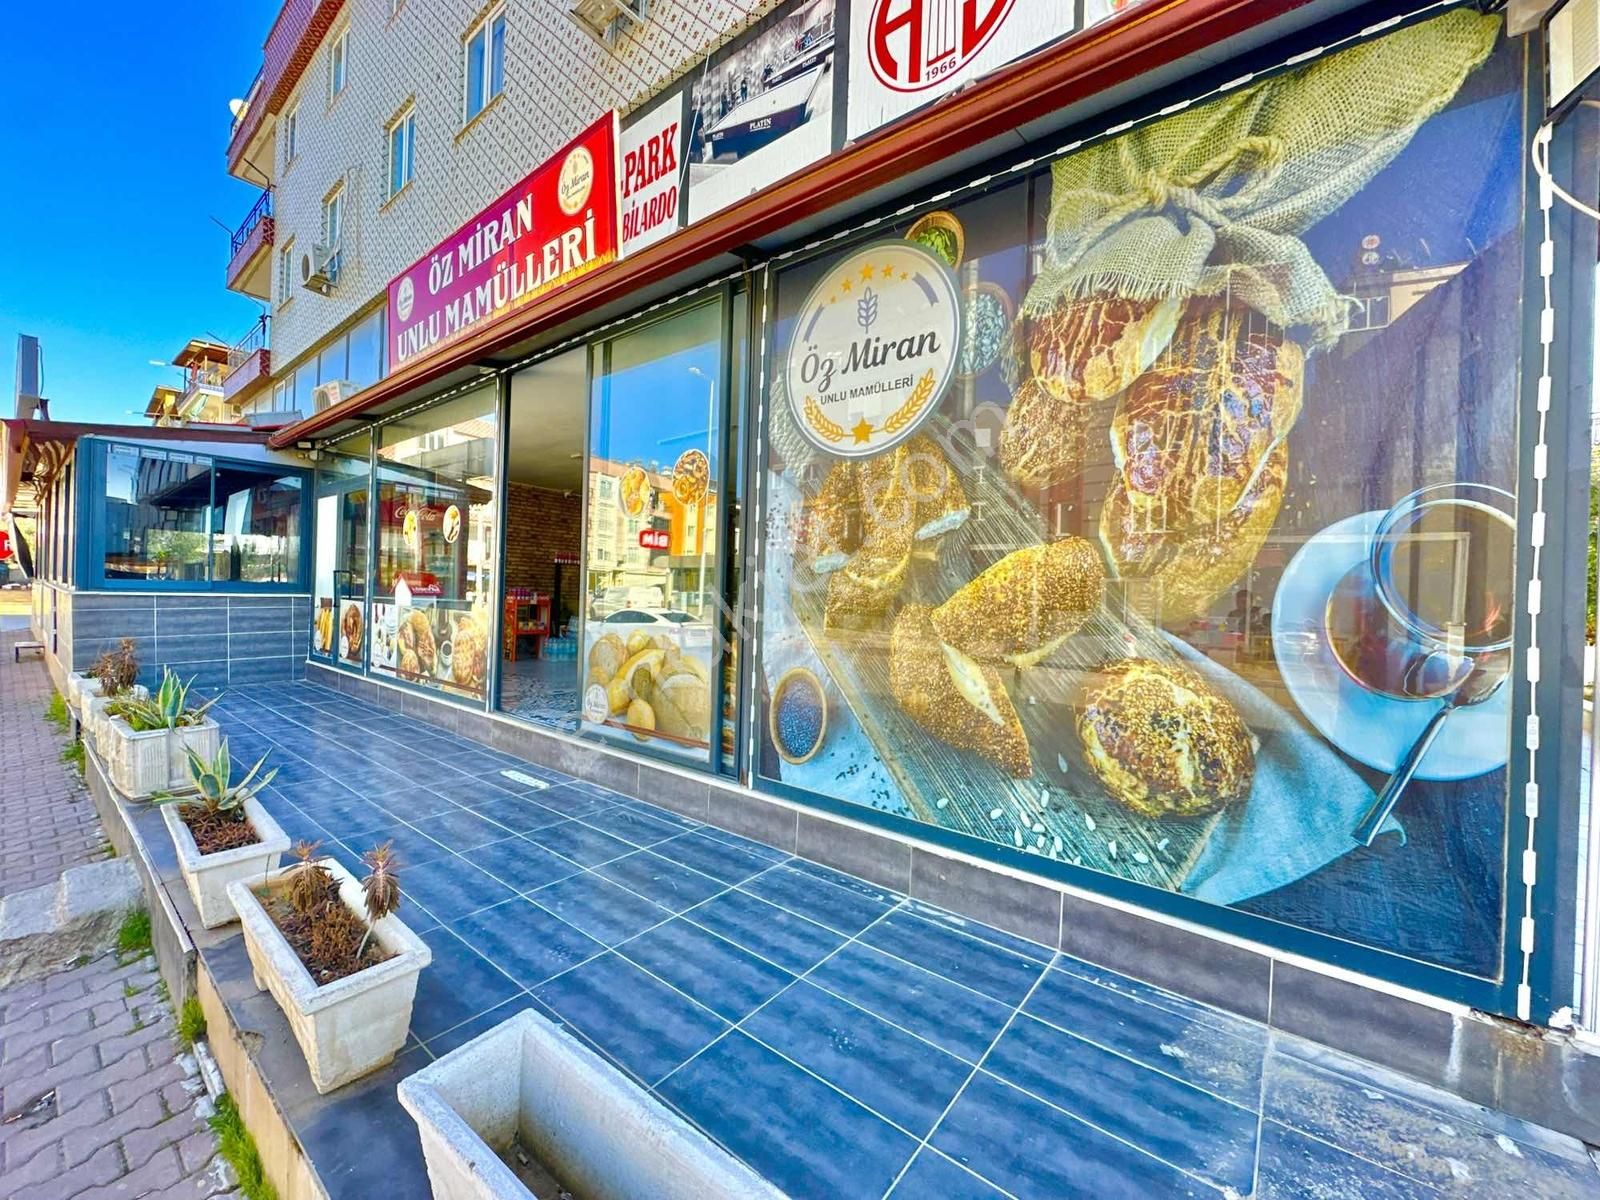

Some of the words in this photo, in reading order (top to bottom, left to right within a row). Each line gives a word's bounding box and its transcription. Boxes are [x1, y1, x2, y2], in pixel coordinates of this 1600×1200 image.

[924, 56, 957, 82] 1966
[428, 251, 453, 295] ÖZ
[458, 193, 533, 278] MİRAN
[397, 310, 440, 362] UNLU
[445, 208, 596, 338] MAMÜLLERİ
[801, 344, 836, 393] Öz
[841, 331, 940, 375] Miran
[820, 391, 847, 405] UNLU
[849, 374, 914, 399] MAMÜLLERİ
